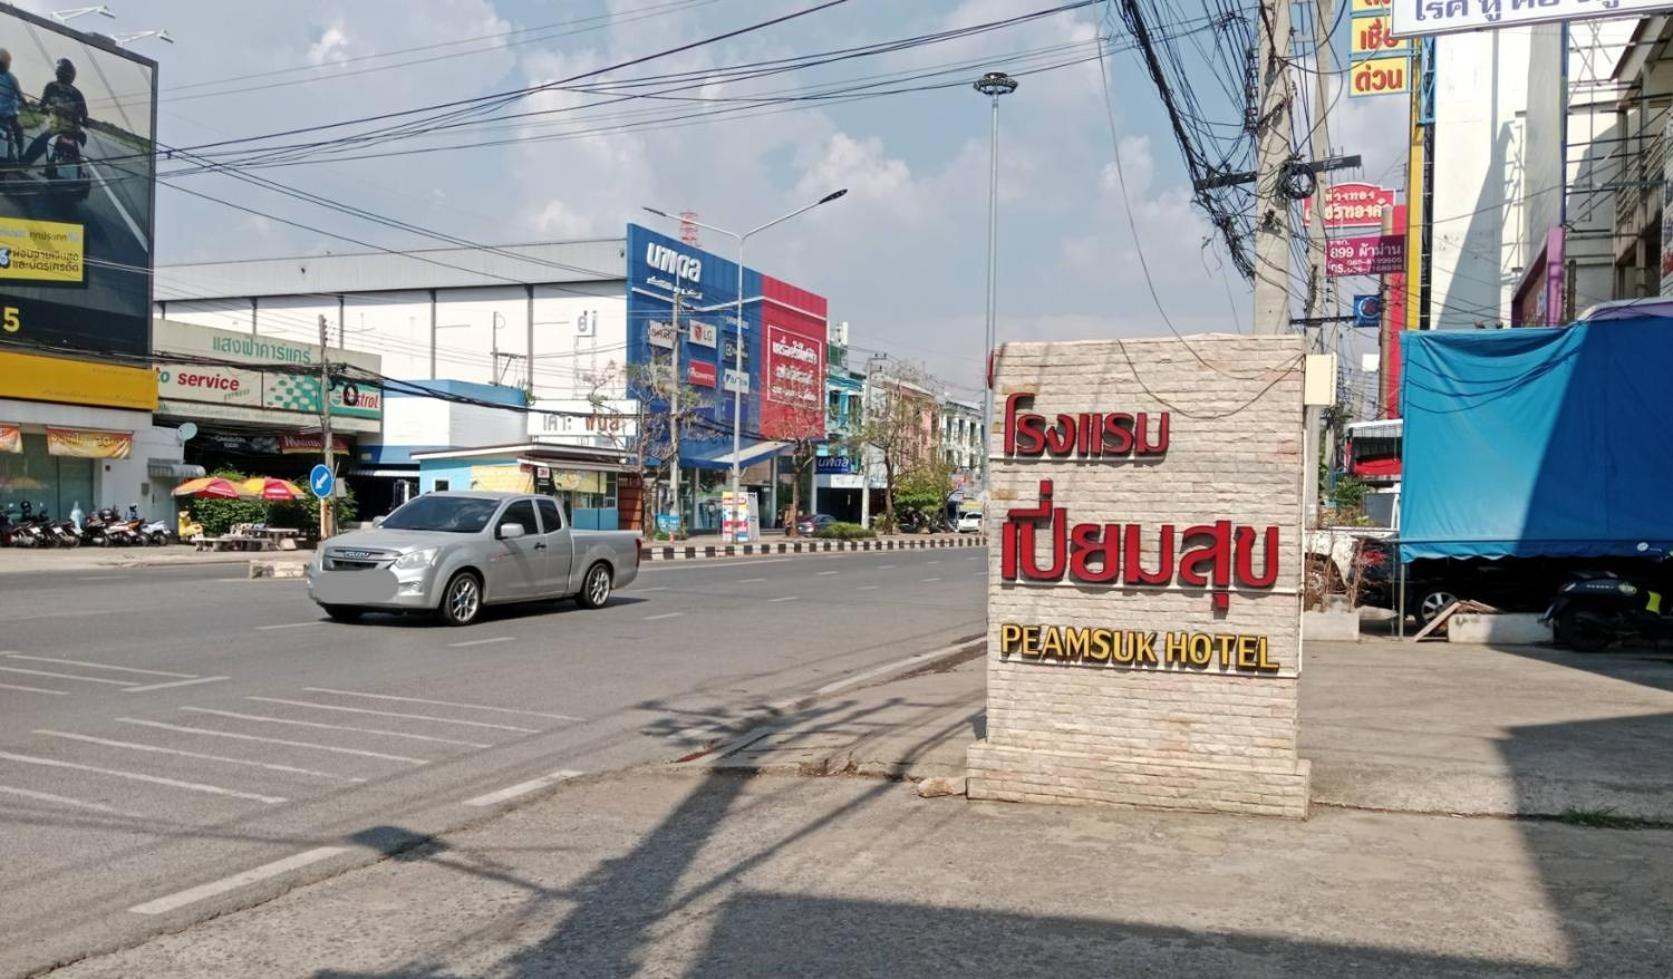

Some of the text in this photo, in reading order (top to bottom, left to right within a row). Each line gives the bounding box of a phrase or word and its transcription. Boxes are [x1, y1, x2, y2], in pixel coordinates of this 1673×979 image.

[1355, 63, 1402, 92] ด่วน
[647, 243, 702, 283] นพดล
[1330, 246, 1354, 259] 899
[1359, 241, 1401, 258] ผ้าม่าน
[704, 329, 713, 342] LG
[177, 372, 239, 391] service
[1004, 392, 1170, 457] โรงแรม
[1000, 479, 1280, 611] เปี่ยมสุข
[1001, 623, 1280, 673] PEAMSUK HOTEL
